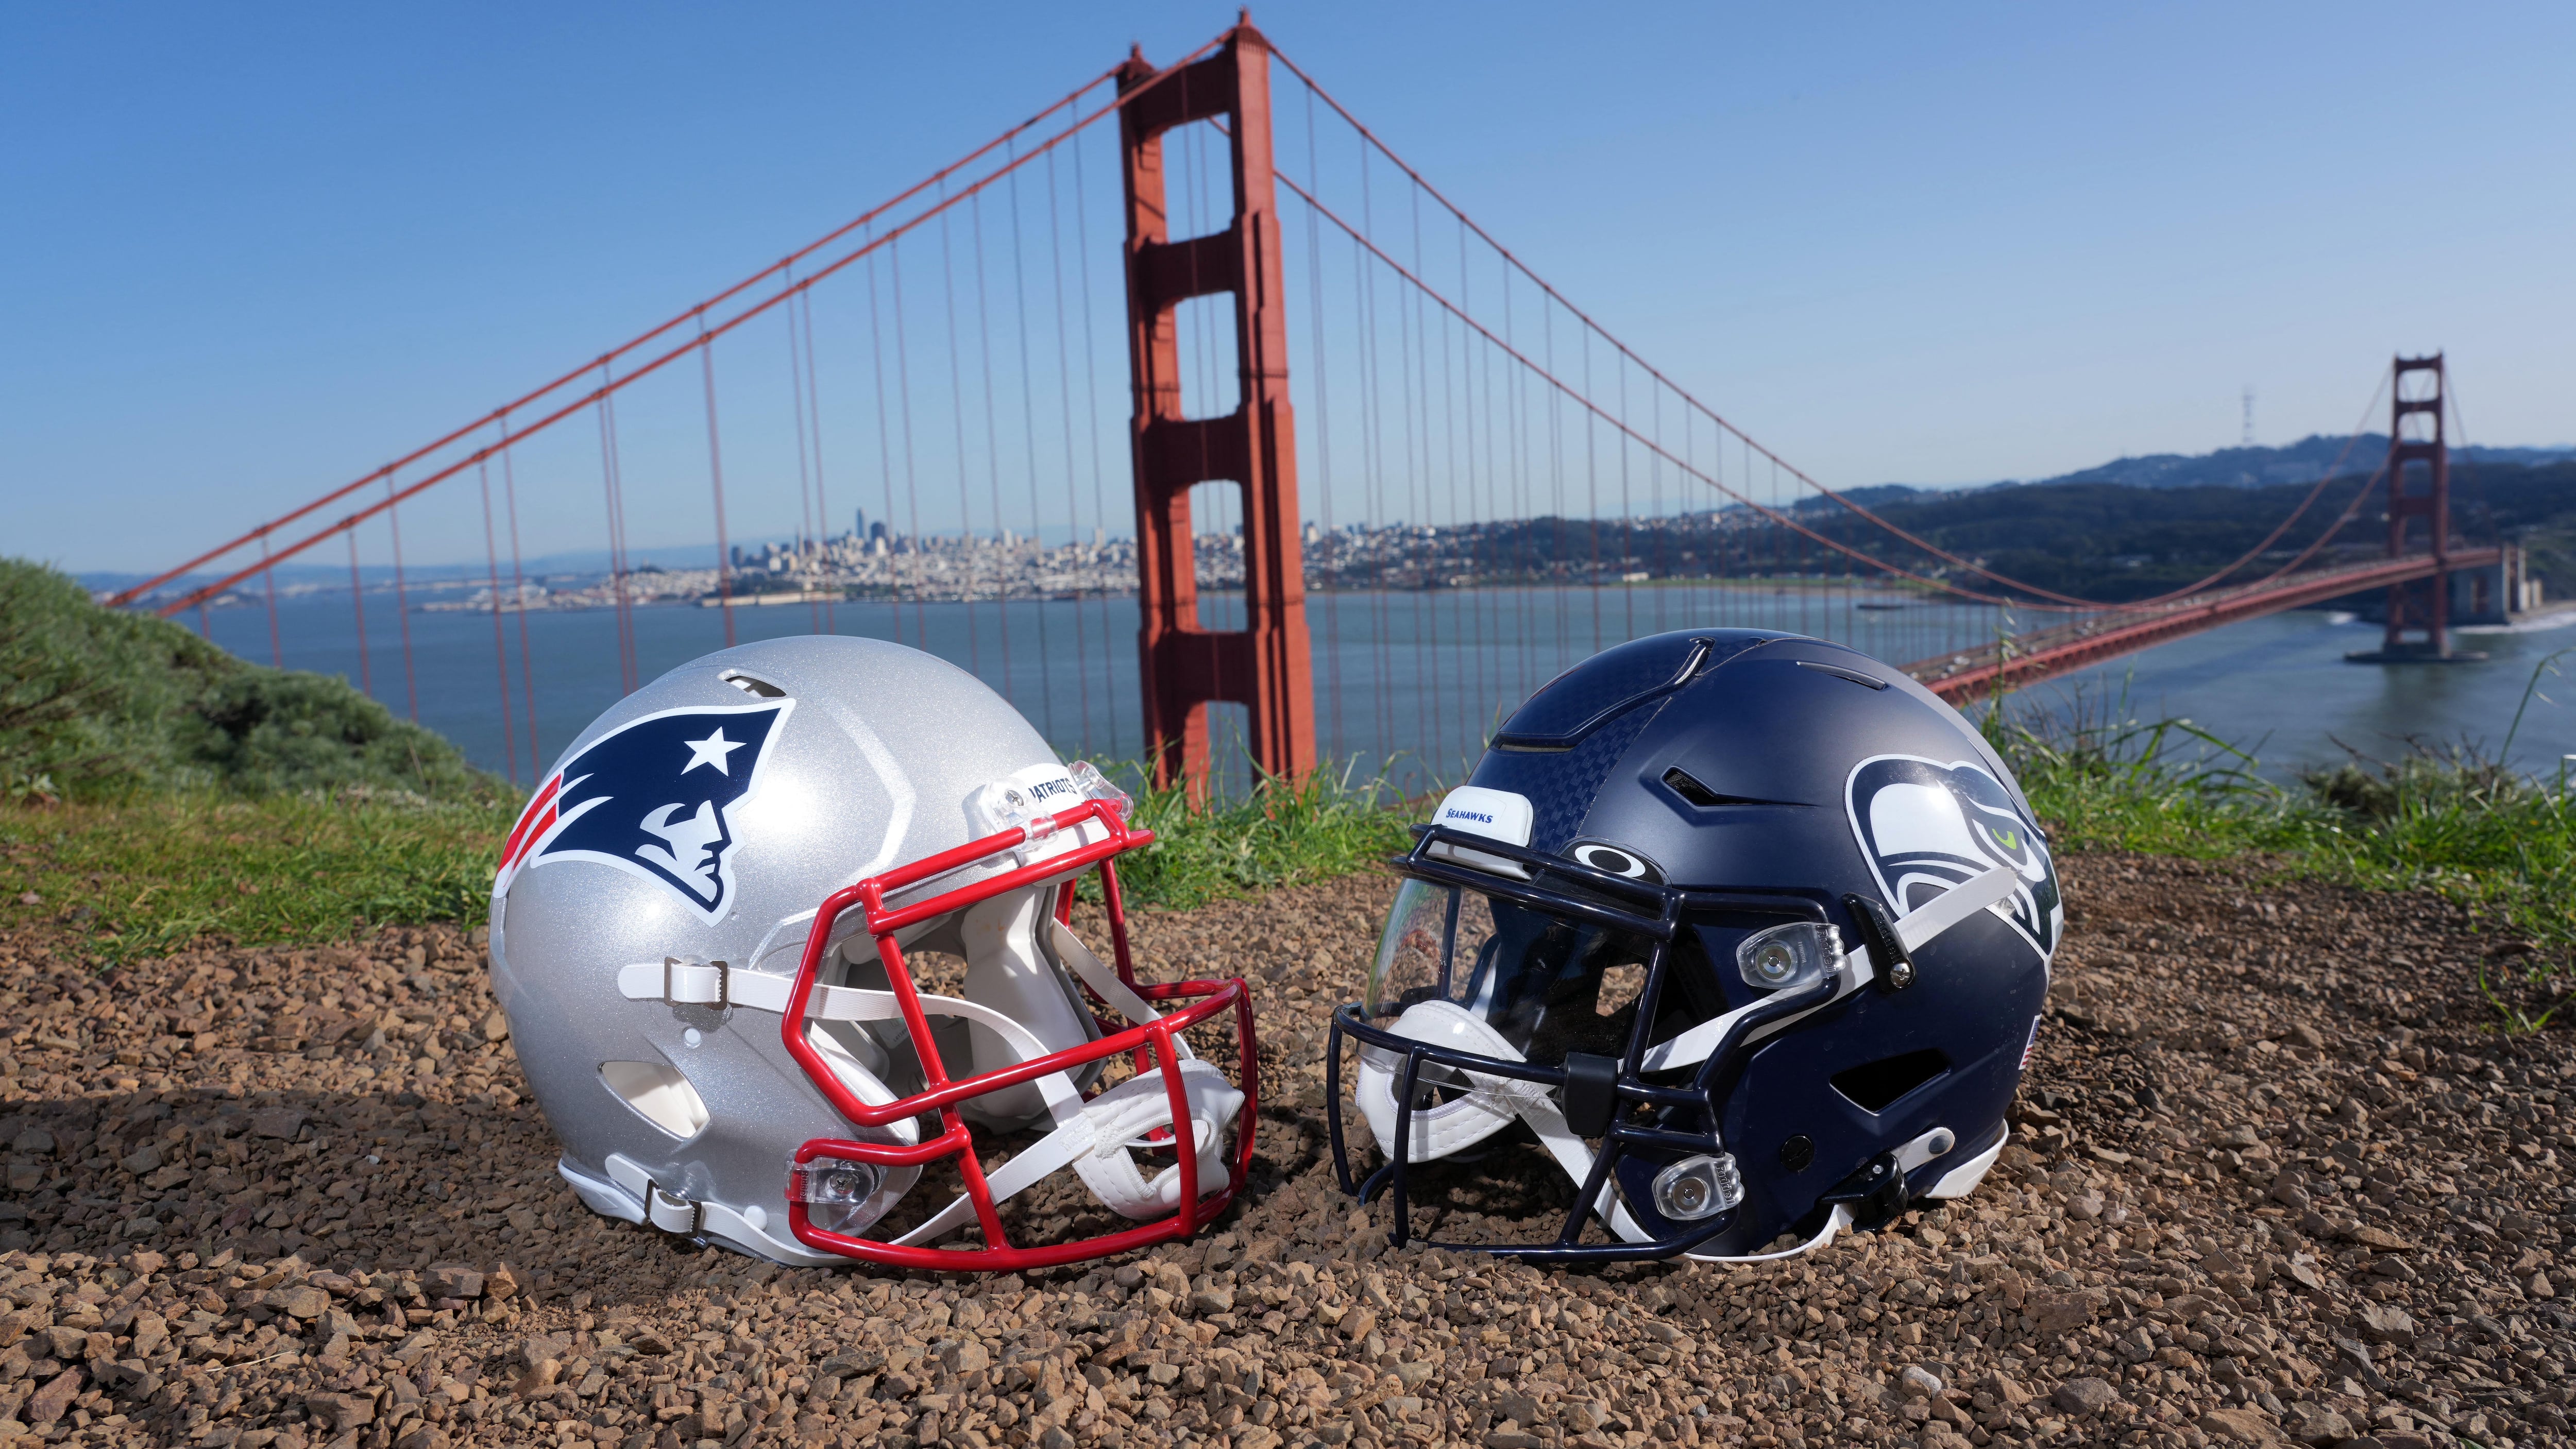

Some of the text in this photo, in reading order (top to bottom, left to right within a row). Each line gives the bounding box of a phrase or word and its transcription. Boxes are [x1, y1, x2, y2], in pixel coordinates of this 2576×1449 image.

[1446, 808, 1493, 823] SEAHAWKS
[1817, 929, 1837, 973] Riddell
[1716, 1164, 1736, 1205] Riddell
